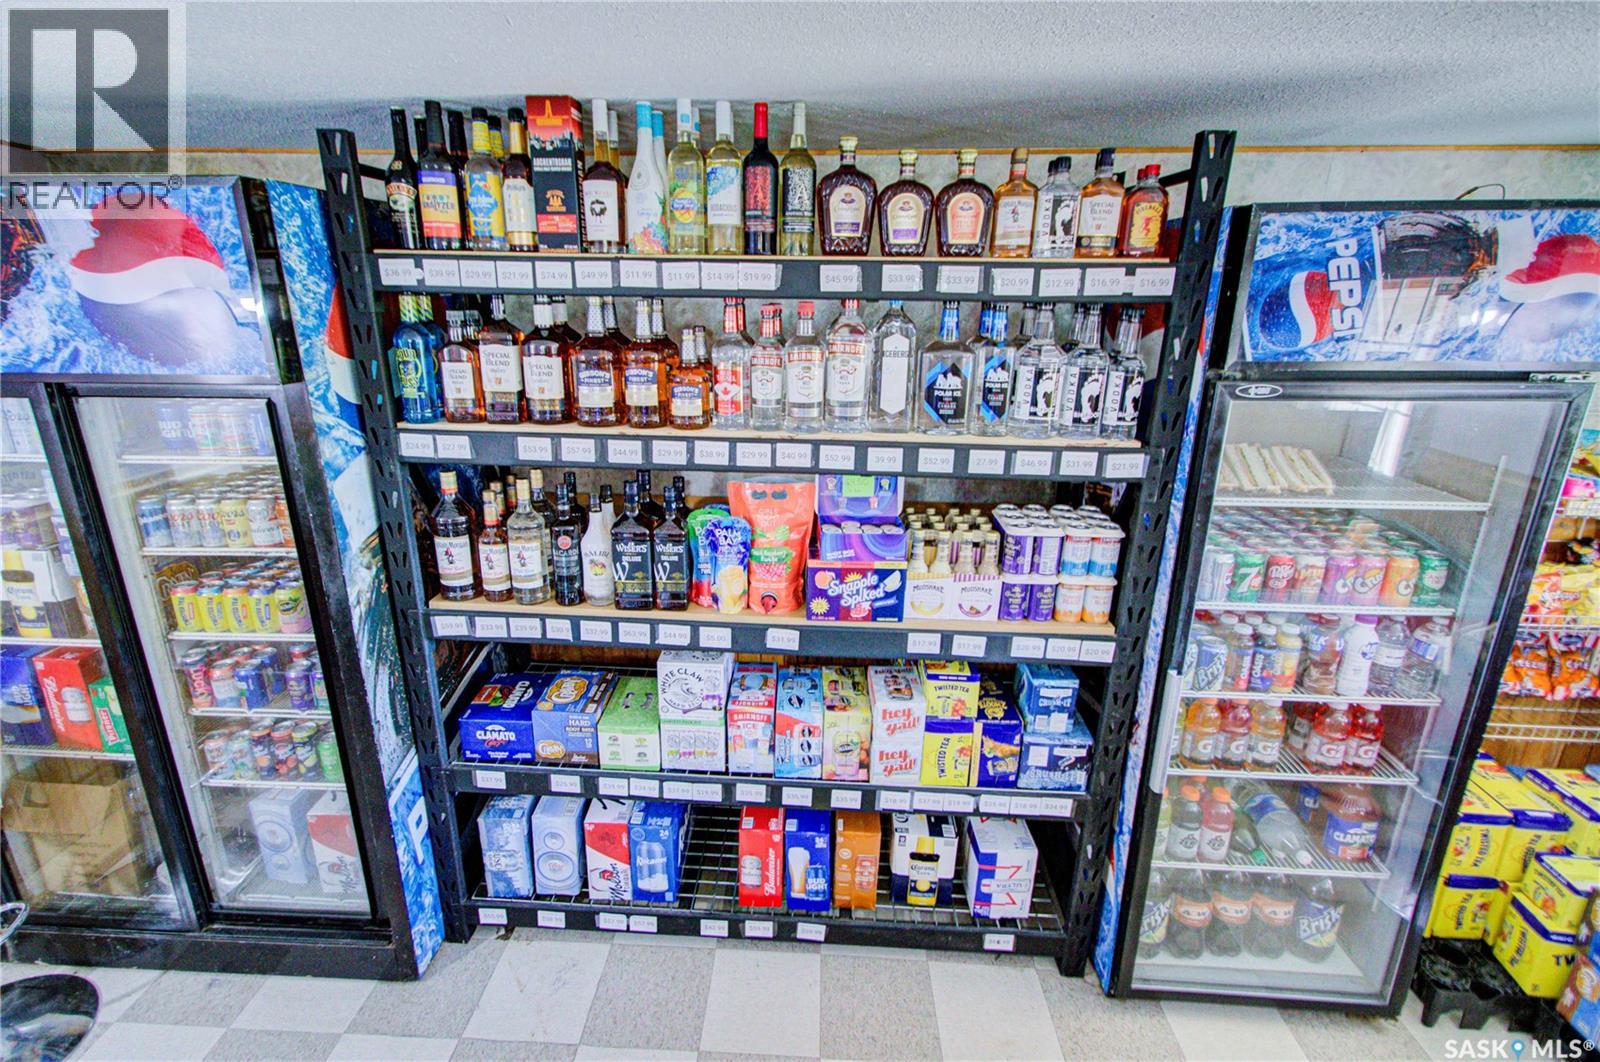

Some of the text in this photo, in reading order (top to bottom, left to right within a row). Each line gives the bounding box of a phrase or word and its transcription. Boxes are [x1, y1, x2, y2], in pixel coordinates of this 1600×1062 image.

[1042, 198, 1052, 237] VODKA
[502, 271, 529, 281] $21.99
[540, 272, 568, 281] $74.99
[580, 270, 608, 280] $49.99
[625, 270, 652, 280] $11.99
[668, 272, 696, 282] $11.99
[706, 272, 735, 282] $14.99
[744, 272, 772, 282] $19.99
[1000, 278, 1028, 287] $20.99
[1045, 279, 1074, 288] $12.99
[1090, 278, 1120, 286] $16.99
[1140, 278, 1170, 286] $16.99
[1326, 237, 1364, 341] PEPSI
[1024, 368, 1034, 404] VODKA
[1066, 370, 1078, 412] VODKA
[1110, 374, 1122, 413] VODKA
[716, 528, 741, 539] PALM
[719, 536, 740, 546] BAY
[828, 572, 879, 597] Snapple
[840, 586, 886, 608] Spiked
[661, 668, 704, 695] WHITE CLAW
[934, 684, 970, 694] TWISTED TEA
[43, 676, 66, 732] Budweiser
[733, 713, 768, 722] SMIRNOFF
[882, 708, 912, 723] hey
[476, 730, 516, 741] CLAMATO
[878, 750, 909, 764] hey
[938, 738, 951, 778] TWISTED TEA
[764, 848, 776, 896] Budweiser
[910, 864, 936, 872] Corona
[1140, 900, 1170, 932] risk
[1299, 909, 1340, 937] Brisk
